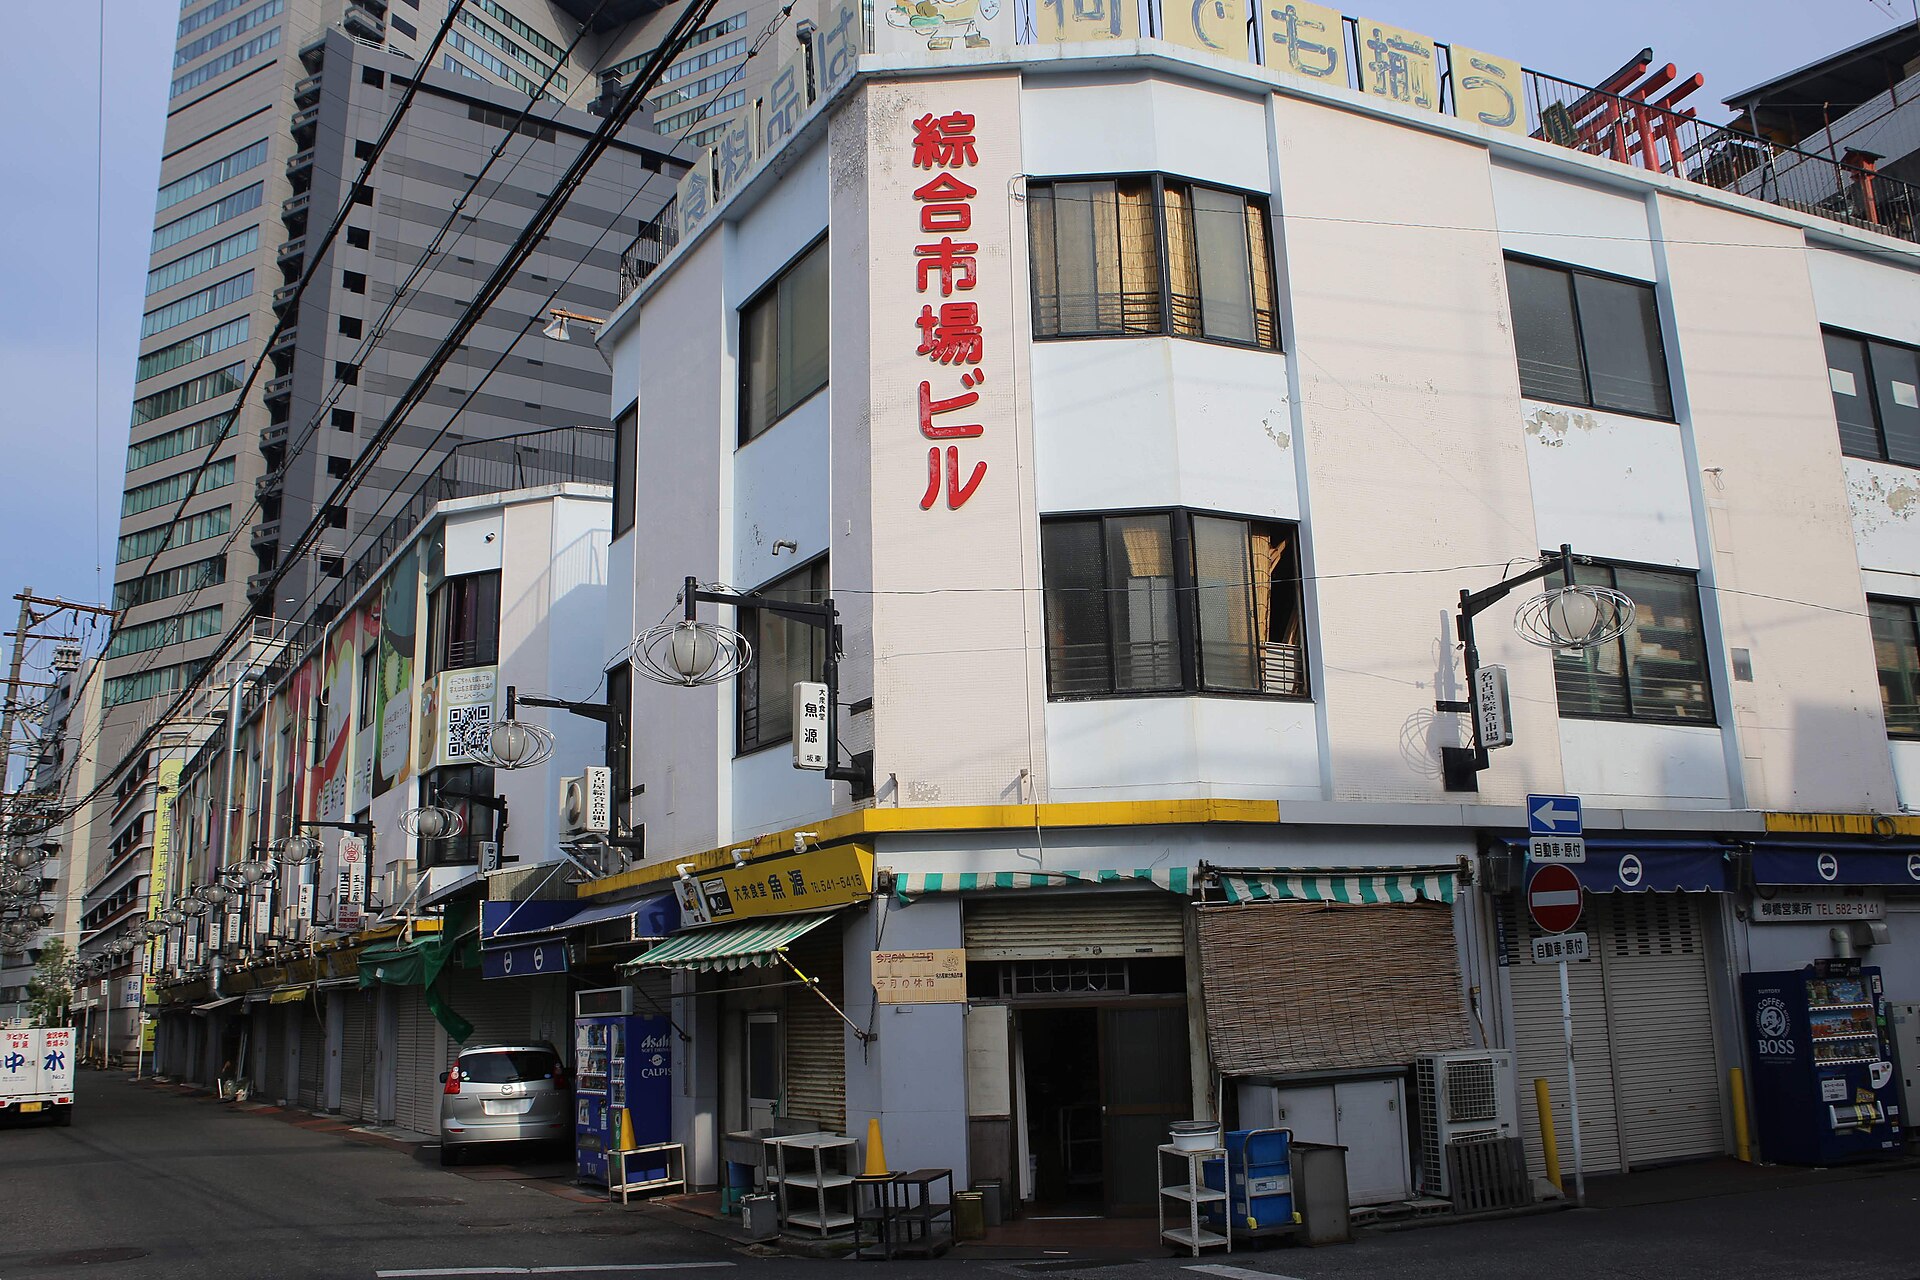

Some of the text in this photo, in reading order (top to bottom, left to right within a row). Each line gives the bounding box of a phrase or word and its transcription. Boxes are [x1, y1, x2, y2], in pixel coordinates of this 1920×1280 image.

[912, 111, 987, 510] 綜合市場ビル
[804, 703, 818, 743] 魚源
[1534, 842, 1581, 858] 自動車・原付
[733, 869, 862, 902] 大衆食堂 魚源 TEL 541-5415
[1762, 903, 1880, 916] 柳橋営業所 TEL 582-8141
[1537, 938, 1583, 959] 自動車・原付
[1758, 998, 1785, 1010] COFFEE
[1758, 1040, 1795, 1055] BOSS
